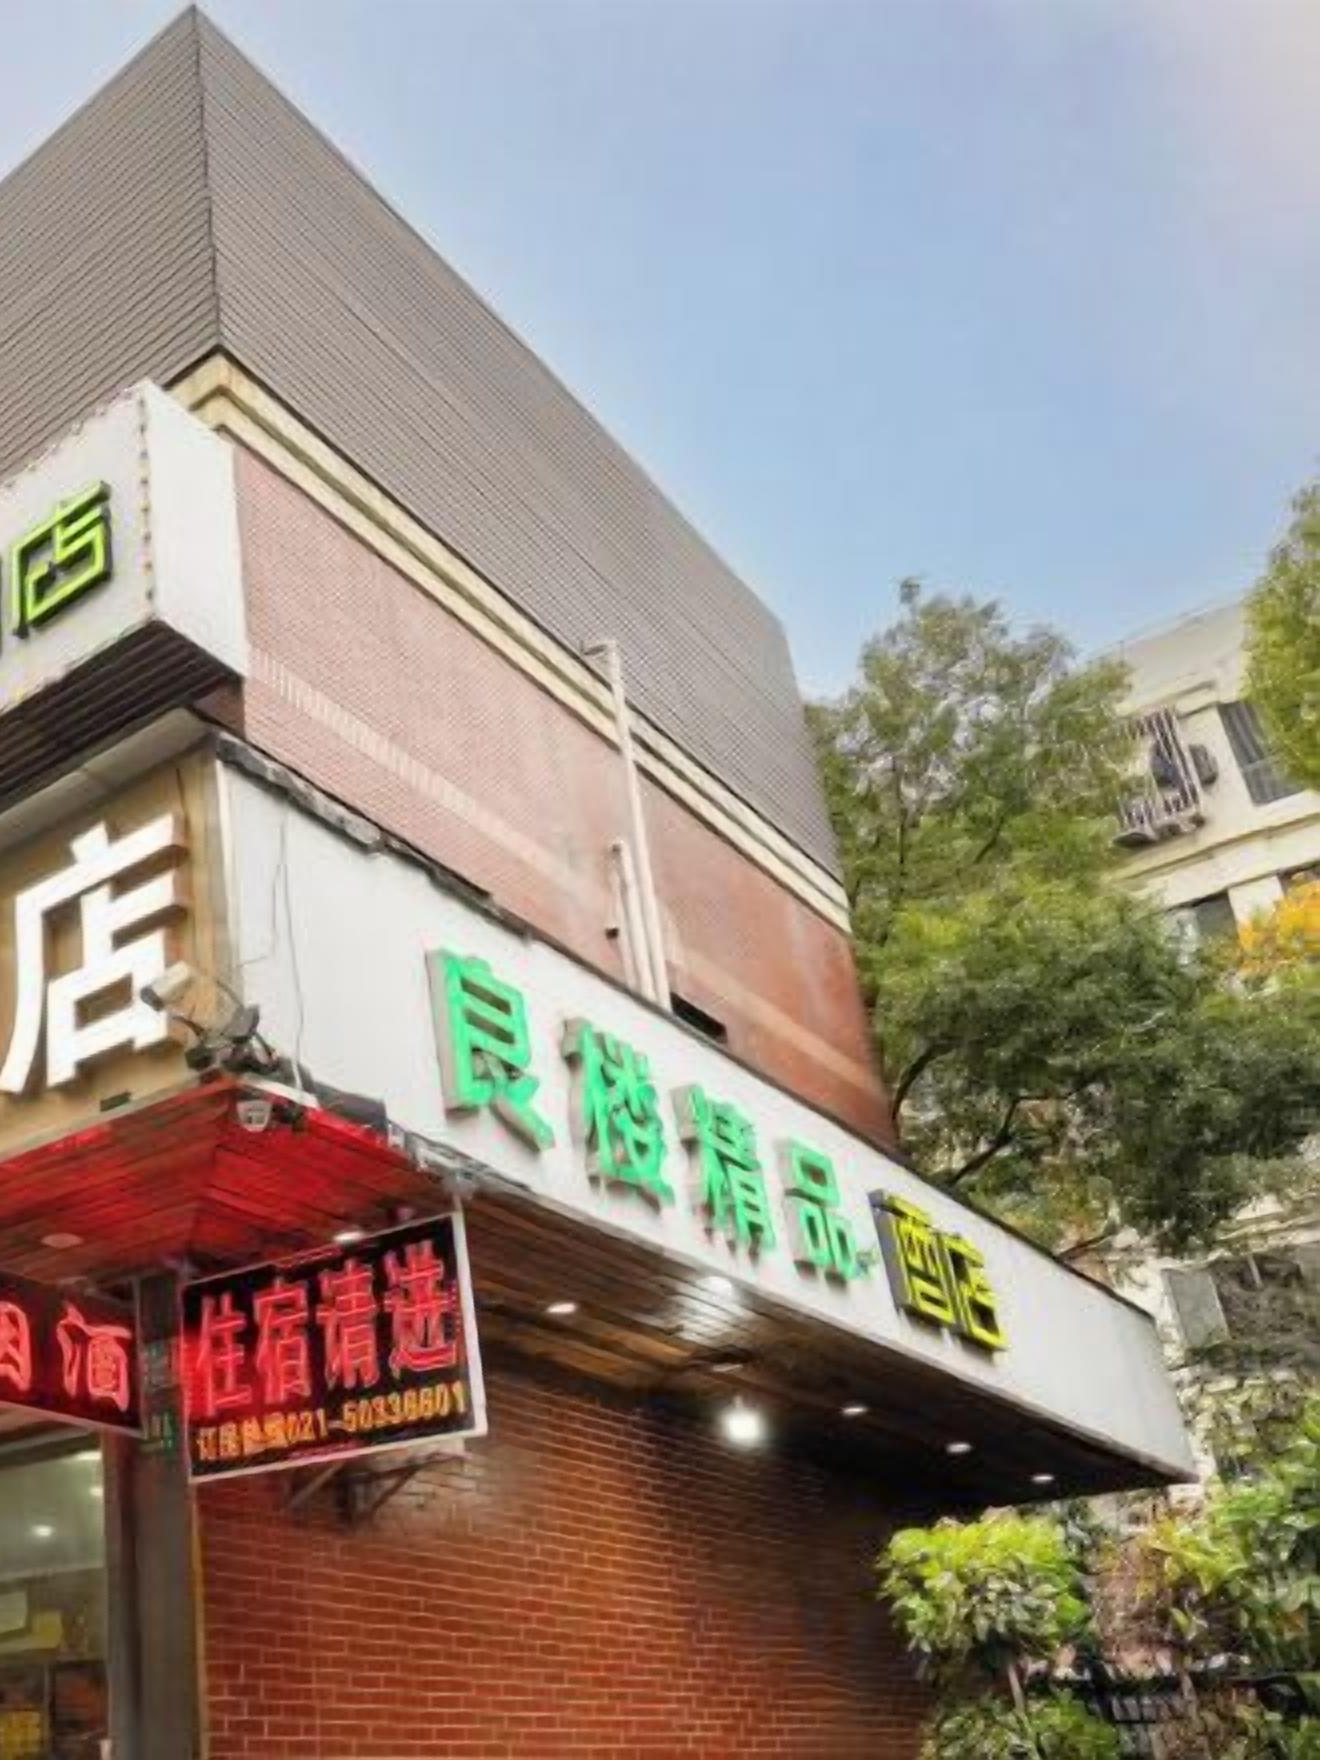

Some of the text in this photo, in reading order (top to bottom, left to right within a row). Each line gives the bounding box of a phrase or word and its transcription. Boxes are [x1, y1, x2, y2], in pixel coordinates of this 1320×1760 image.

[426, 948, 1008, 1352] 良楼精品酒店
[196, 1240, 460, 1416] 住宿请进
